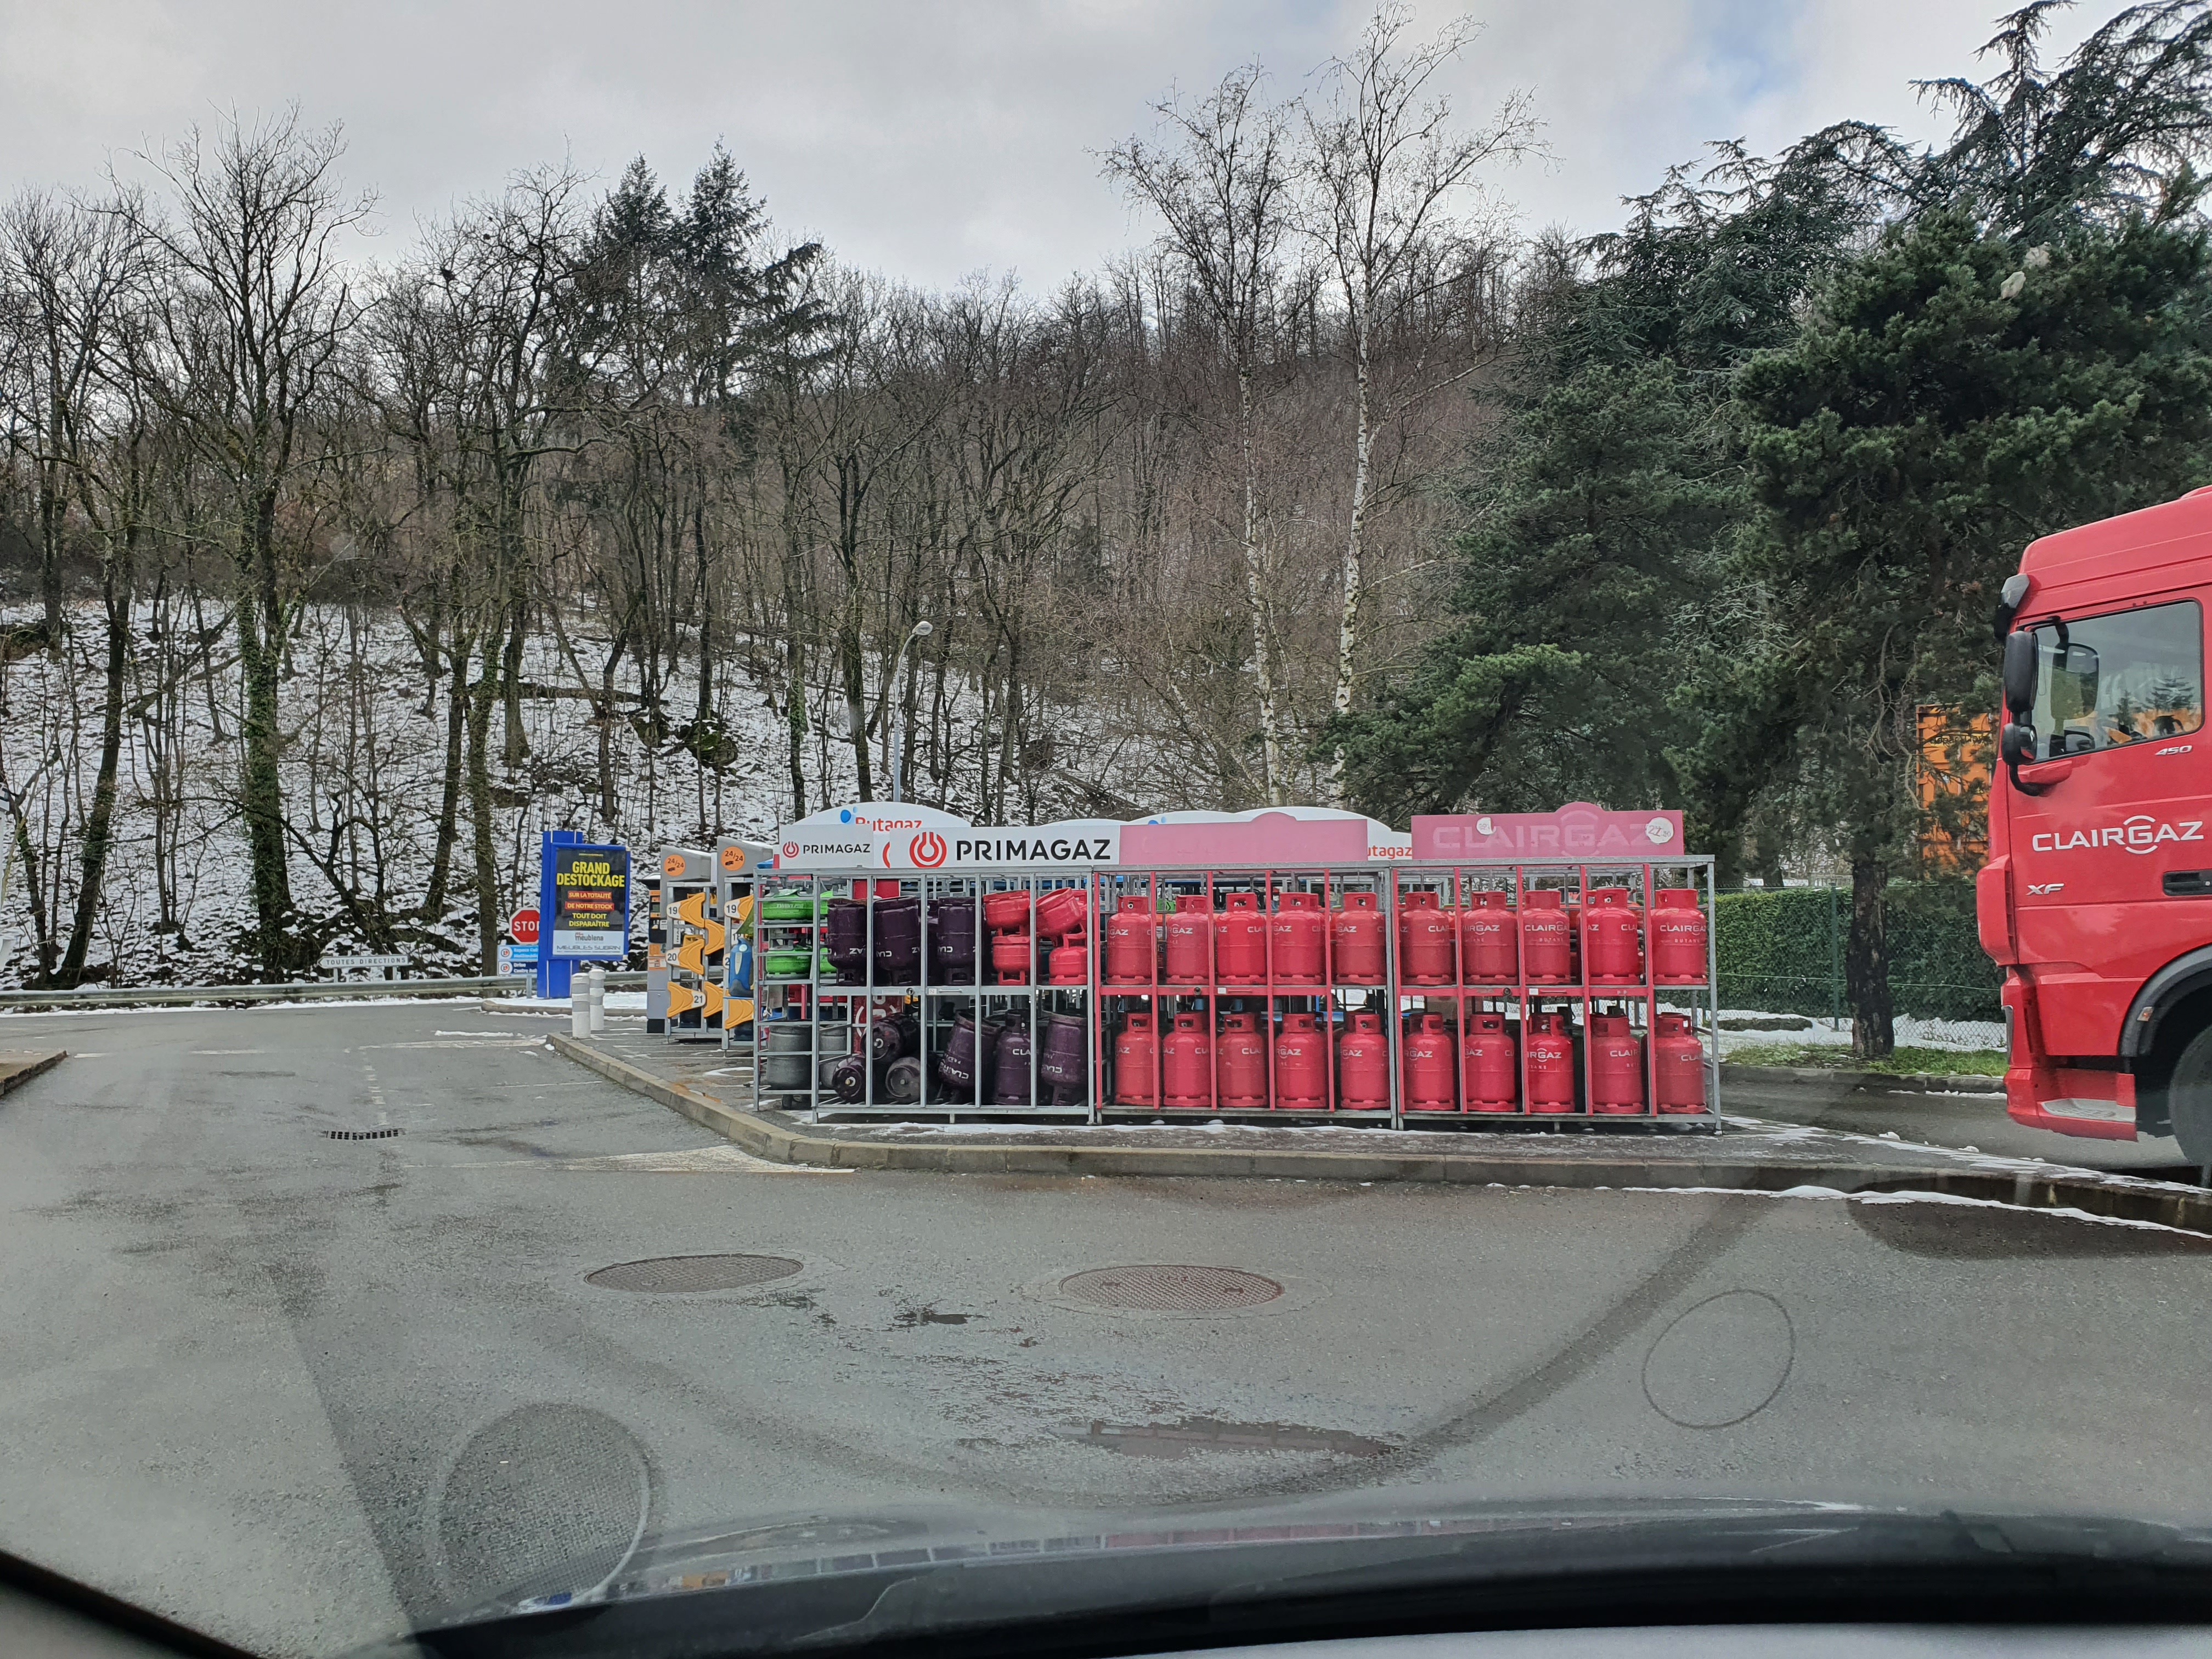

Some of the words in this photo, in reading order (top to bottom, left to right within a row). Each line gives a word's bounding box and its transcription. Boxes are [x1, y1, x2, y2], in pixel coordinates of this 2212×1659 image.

[2154, 745, 2193, 756] 450
[2032, 821, 2205, 851] CLAIRGAZ
[803, 843, 871, 854] PRIMAGAZ
[956, 839, 1111, 861] PRIMAGAZ
[724, 850, 743, 861] 24/24
[572, 861, 610, 874] GRAND
[667, 858, 684, 868] 24/24
[556, 873, 625, 887] DESTOCKAGE
[2025, 883, 2065, 896] XF
[668, 906, 678, 915] 19
[726, 905, 737, 913] 19
[667, 953, 677, 961] 20
[694, 995, 703, 1003] 21
